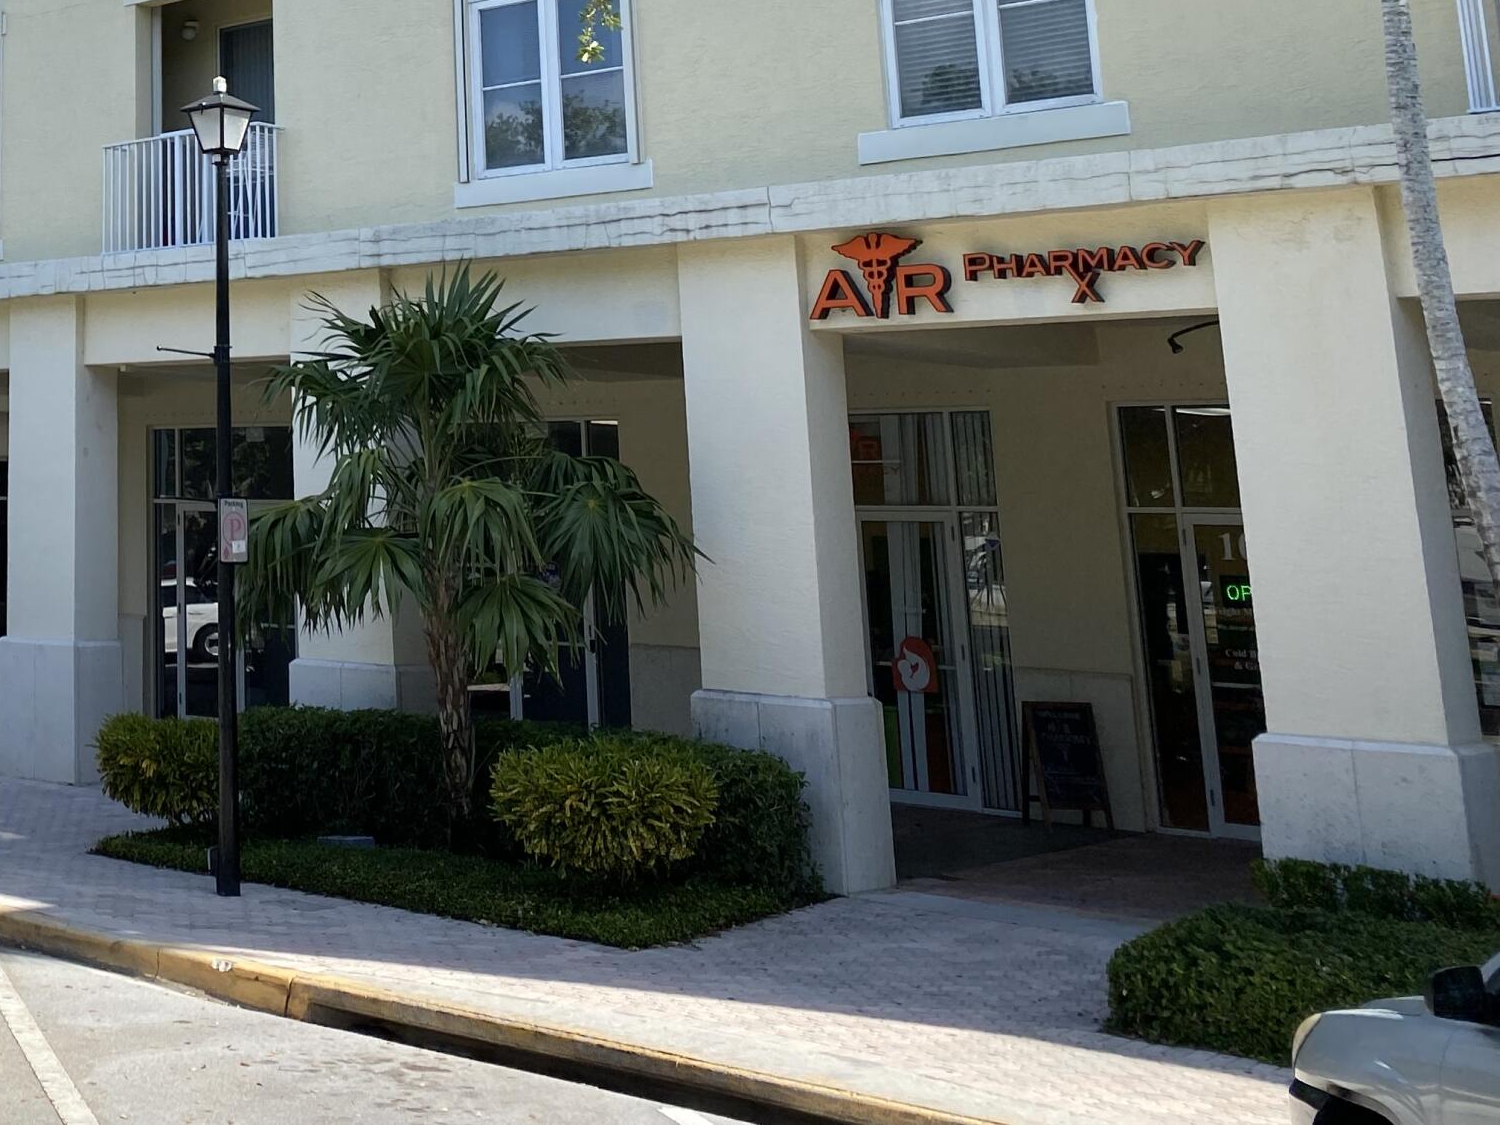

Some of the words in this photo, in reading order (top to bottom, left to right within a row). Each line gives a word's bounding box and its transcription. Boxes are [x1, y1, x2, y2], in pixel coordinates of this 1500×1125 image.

[963, 240, 1205, 282] PHARMACY
[228, 518, 241, 541] P
[1227, 585, 1252, 601] OP
